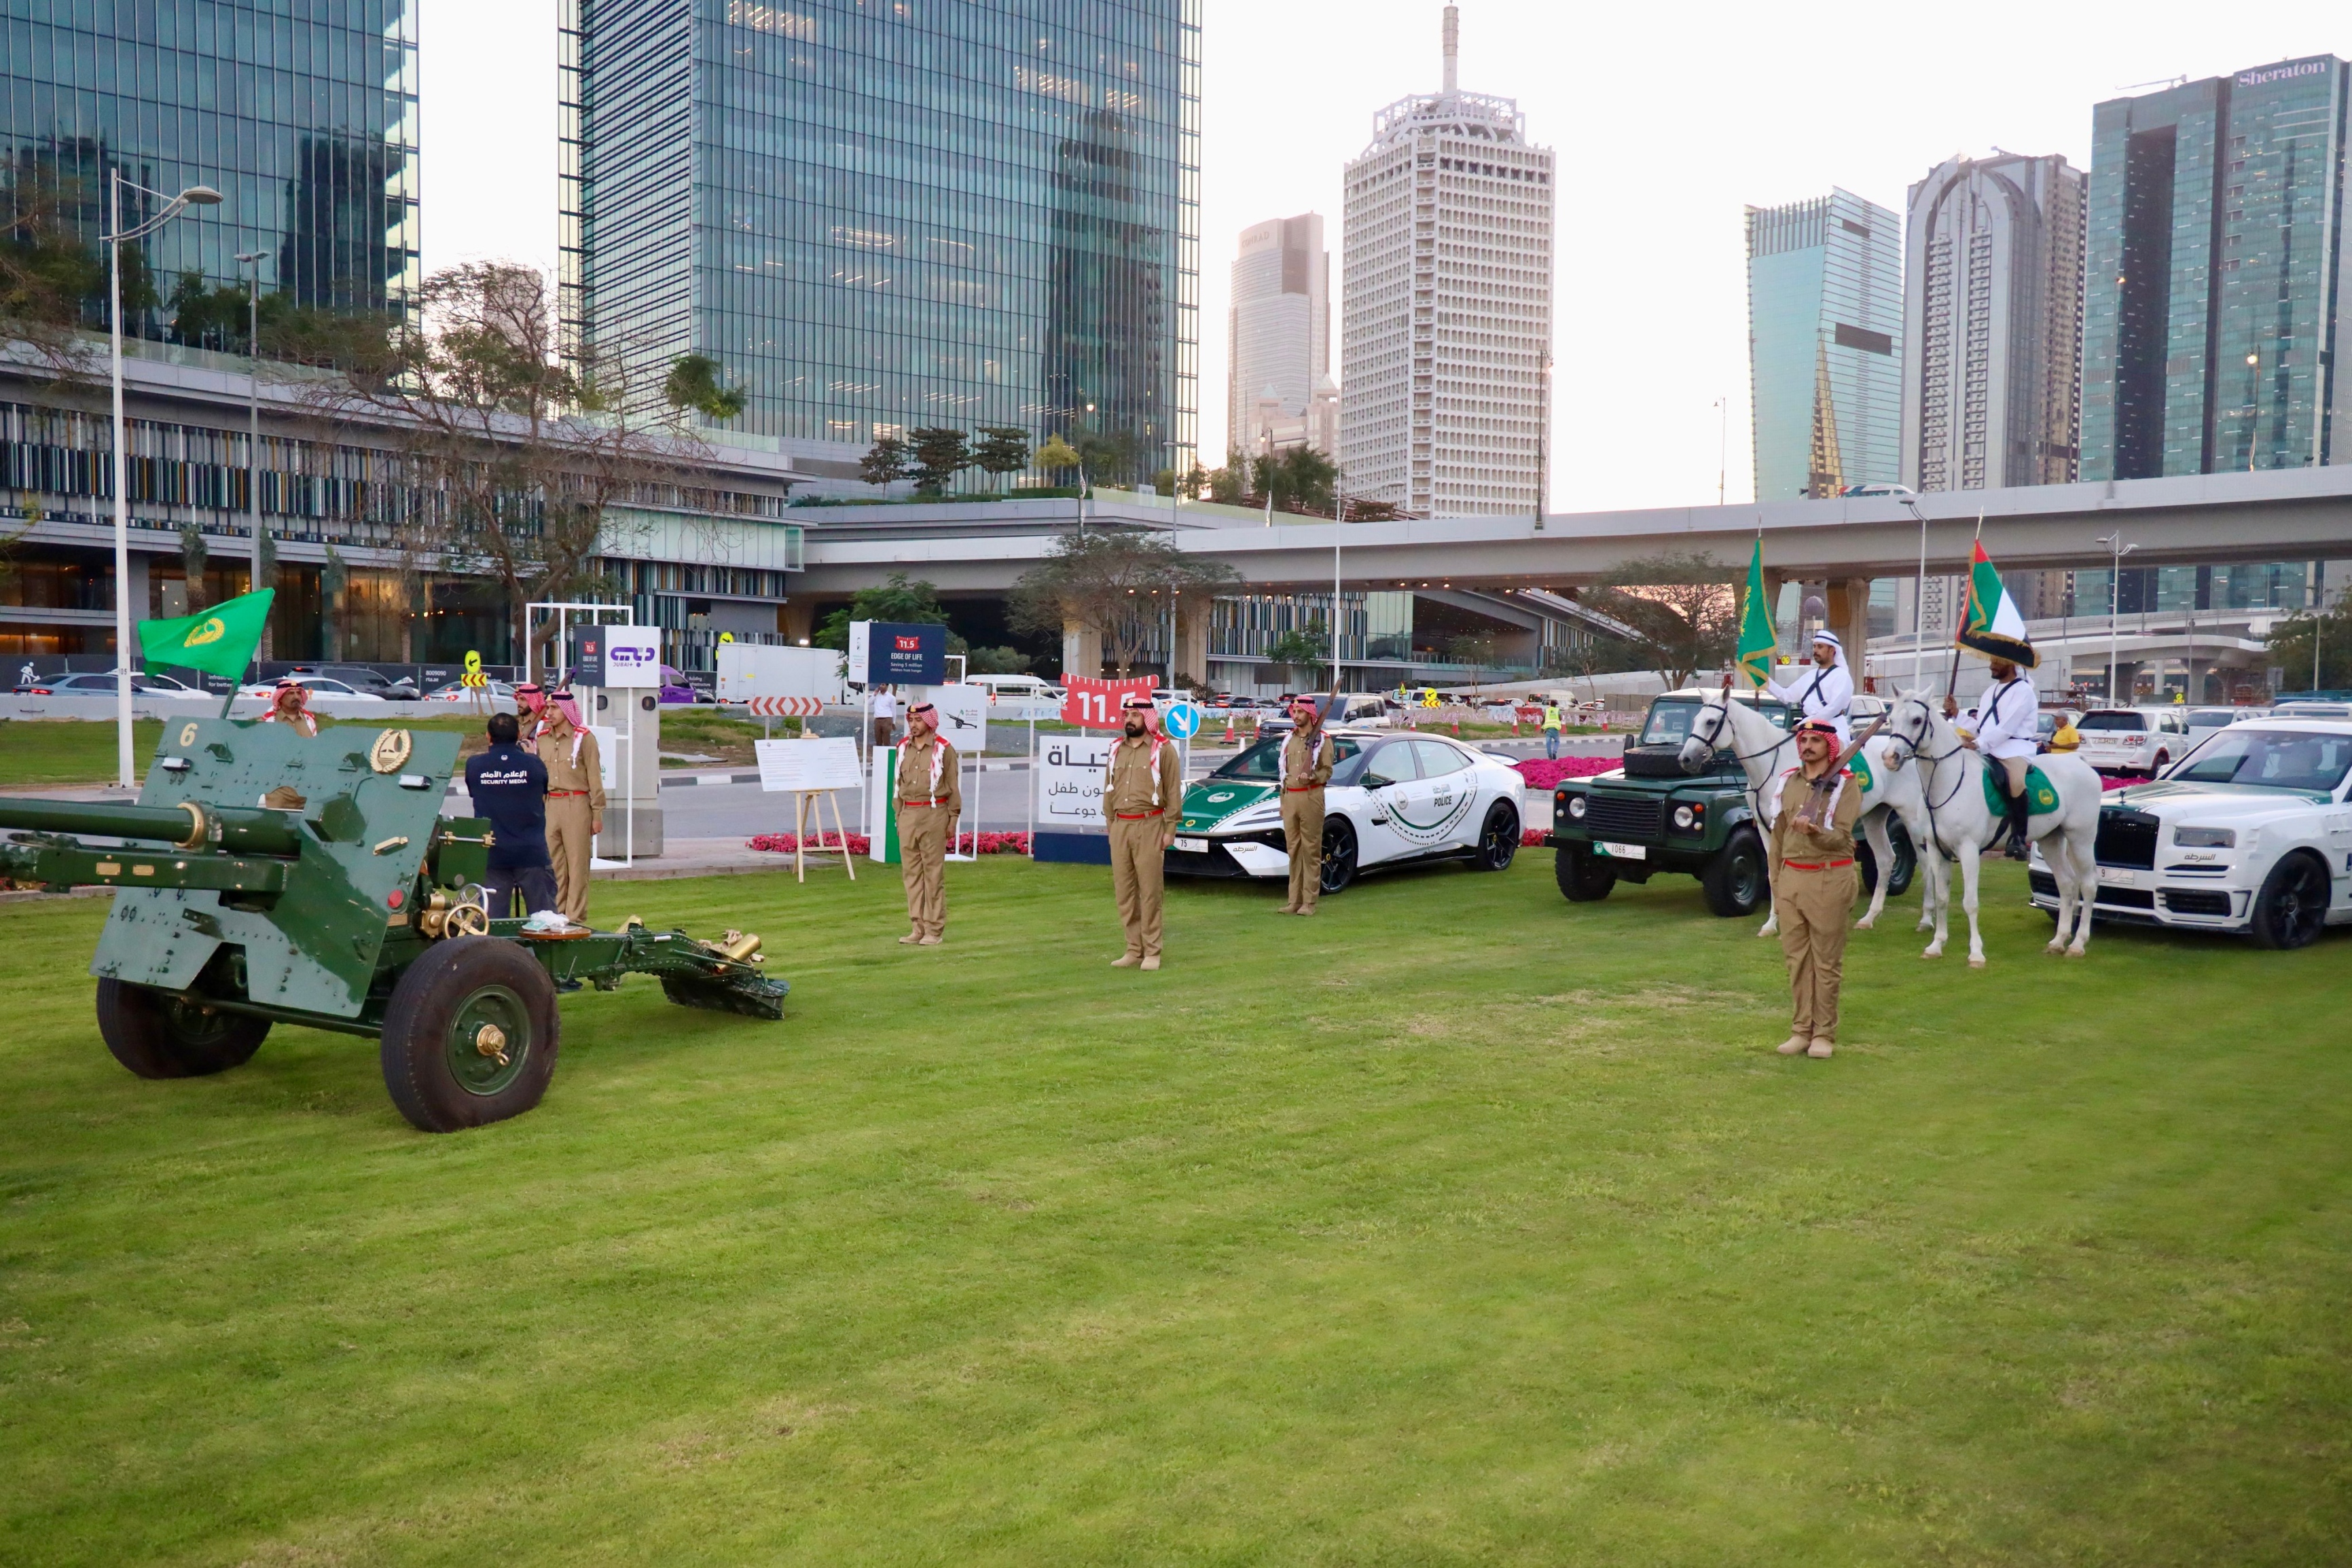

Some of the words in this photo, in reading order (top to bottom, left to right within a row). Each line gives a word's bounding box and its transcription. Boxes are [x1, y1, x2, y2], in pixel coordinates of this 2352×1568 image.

[2239, 62, 2326, 88] Sheraton
[1242, 231, 1269, 248] CONRAD
[899, 640, 915, 649] 11.5
[180, 723, 198, 746] 6
[1049, 782, 1078, 796] طفل
[1434, 796, 1452, 807] POLICE
[1180, 839, 1187, 847] 75
[1233, 845, 1257, 854] الشرطة
[1612, 845, 1626, 854] 1066
[2184, 853, 2216, 862] الشرطة
